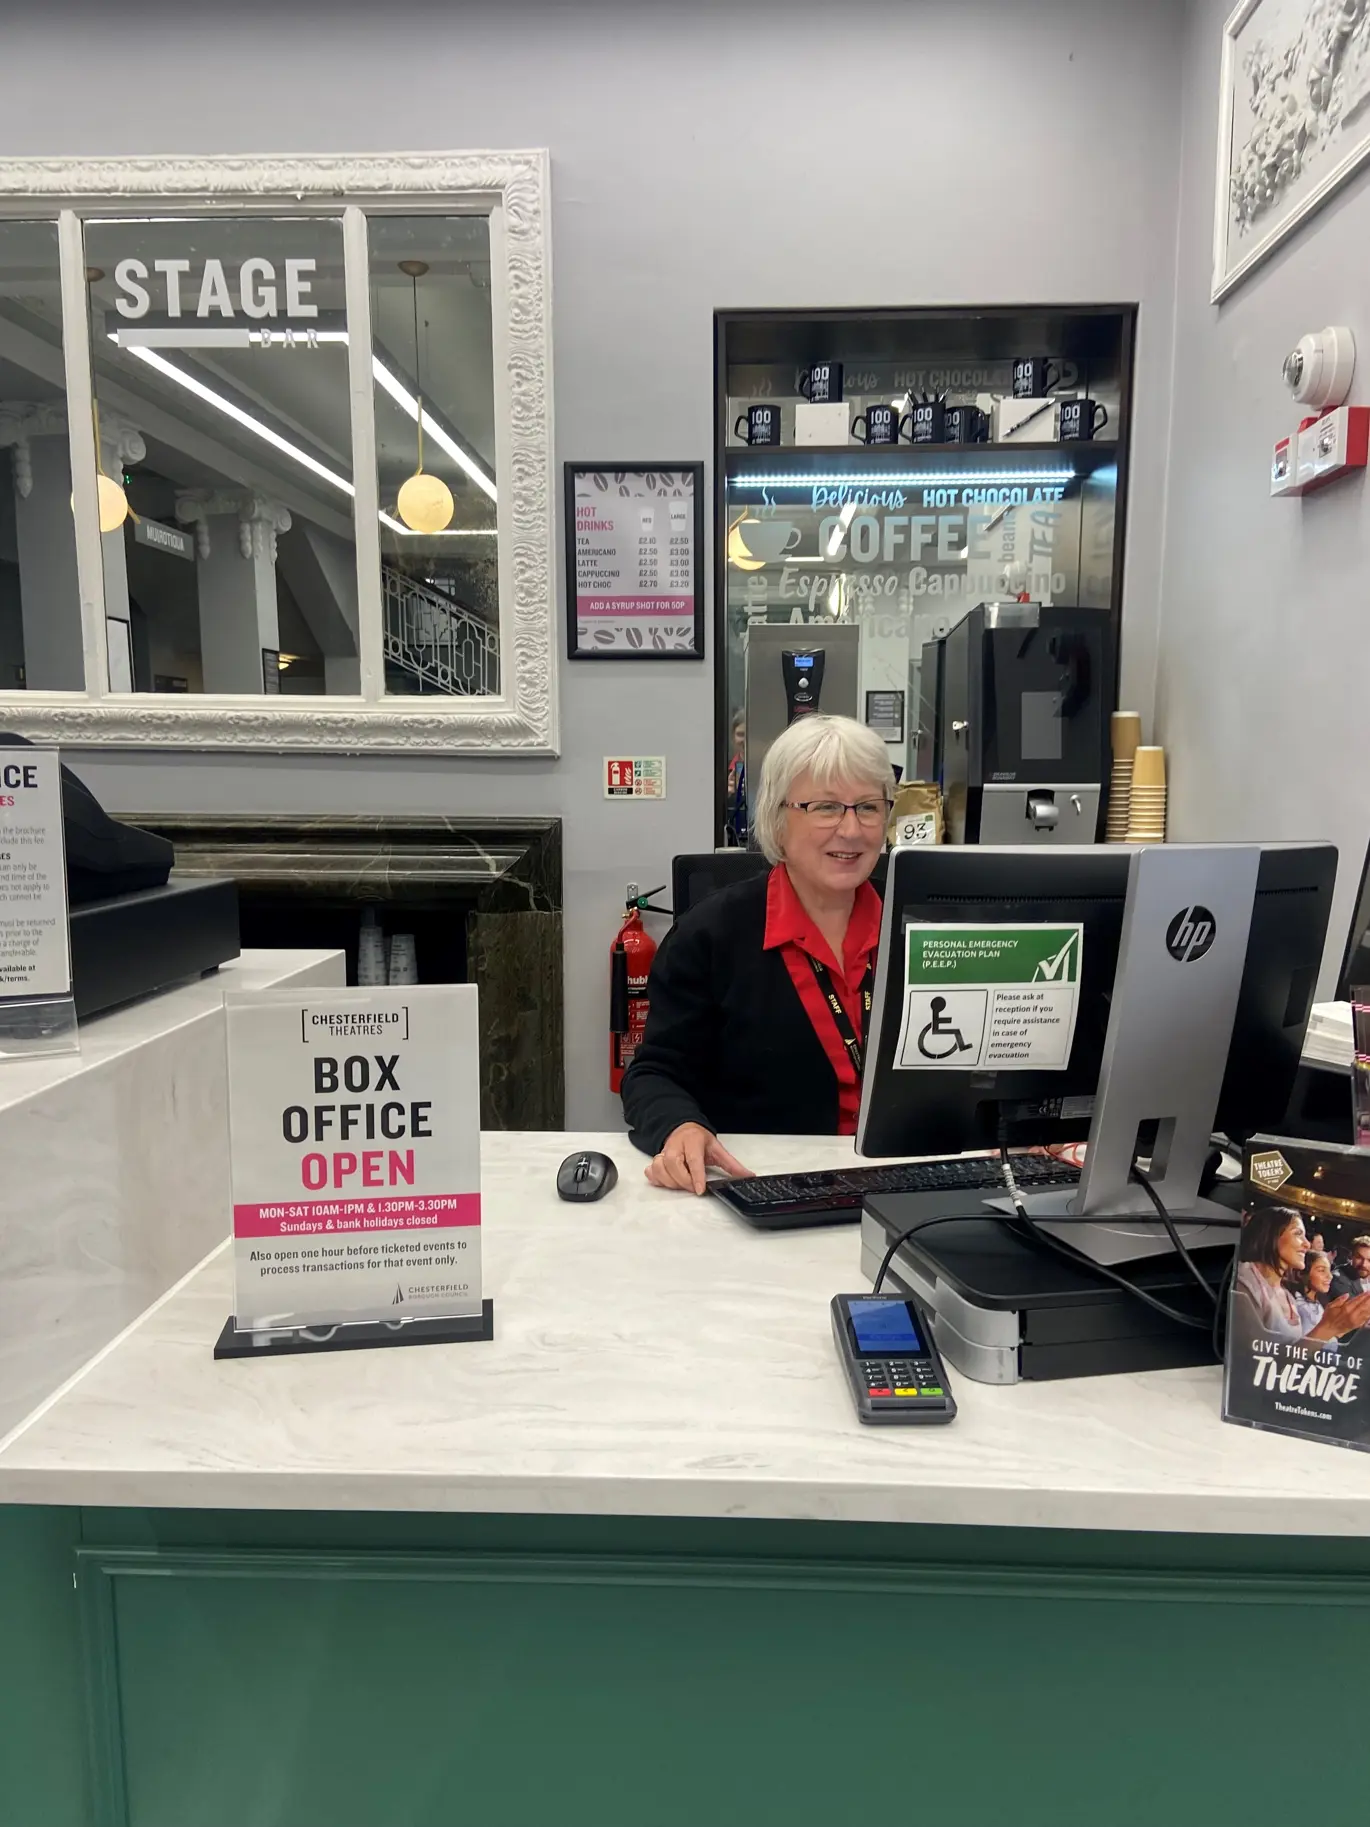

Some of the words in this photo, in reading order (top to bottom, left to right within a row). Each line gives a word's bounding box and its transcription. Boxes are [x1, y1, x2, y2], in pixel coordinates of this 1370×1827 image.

[114, 257, 319, 319] STAGE
[260, 328, 319, 349] BAR
[811, 366, 830, 382] 100
[1013, 363, 1033, 379] 100
[752, 410, 772, 425] 100
[870, 410, 891, 425] 100
[914, 406, 933, 423] 100
[1061, 405, 1081, 420] 100
[810, 484, 908, 513] Delicious
[922, 488, 958, 508] HOT
[961, 486, 1065, 507] CHOCOLATE
[576, 506, 597, 517] HOT
[576, 520, 614, 531] DRINKS
[577, 537, 590, 545] TEA
[669, 537, 689, 545] £2.50
[818, 514, 993, 564] COFFEE
[1028, 508, 1063, 564] TEA
[577, 548, 617, 556] AMERICANO
[638, 548, 658, 556] £2.50
[669, 548, 690, 556] £3.00
[577, 559, 598, 567] LATTE
[669, 559, 690, 567] £3.00
[577, 570, 620, 578] CAPPUCCINO
[578, 581, 592, 589] HOT
[592, 581, 612, 589] CHOC
[638, 580, 658, 588] £2.70
[589, 602, 605, 610] ADD
[605, 602, 611, 610] A
[611, 602, 635, 610] SYRUP
[636, 601, 655, 610] SHOT
[656, 601, 670, 609] FOR
[0, 765, 38, 788] CE
[15, 826, 46, 836] brochure
[26, 918, 56, 927] returned
[5, 930, 22, 940] prior
[23, 929, 32, 938] to
[32, 929, 43, 937] the
[1171, 905, 1212, 962] hp
[9, 939, 31, 949] charge
[922, 940, 967, 949] PERSONAL
[968, 940, 1019, 948] EMERGENCY
[922, 950, 977, 958] EVACUATION
[978, 950, 1000, 958] PLAN
[922, 960, 957, 969] (P.E.E.P.)
[864, 990, 872, 1011] STAFF
[996, 993, 1021, 1001] Please
[1022, 993, 1035, 1001] ask
[828, 993, 843, 1015] STAFF
[995, 1005, 1031, 1014] reception
[1032, 1004, 1039, 1013] if
[1039, 1006, 1054, 1014] you
[311, 1012, 399, 1025] CHESTERFIELD
[993, 1017, 1021, 1026] require
[329, 1024, 383, 1037] THEATRES
[992, 1029, 1000, 1037] in
[1019, 1028, 1028, 1036] of
[990, 1041, 1032, 1049] emergency
[988, 1051, 1030, 1059] evacuation
[313, 1054, 401, 1094] BOX
[282, 1101, 433, 1144] OFFICE
[301, 1149, 415, 1191] OPEN
[1253, 1158, 1284, 1171] THEATRE
[1257, 1167, 1285, 1179] TOKENS
[259, 1205, 310, 1219] MON-SAT
[311, 1203, 365, 1217] 10AM-1PM
[366, 1202, 376, 1214] &
[377, 1198, 458, 1213] 1.30PM-3.30PM
[279, 1220, 324, 1233] Sundays
[325, 1219, 335, 1230] &
[336, 1218, 361, 1230] bank
[362, 1215, 405, 1229] holidays
[405, 1213, 438, 1225] closed
[249, 1250, 272, 1262] Also
[274, 1250, 299, 1262] open
[300, 1249, 320, 1259] one
[321, 1246, 345, 1258] hour
[346, 1244, 379, 1257] before
[380, 1242, 421, 1255] ticketed
[422, 1240, 456, 1252] events
[457, 1239, 467, 1250] to
[260, 1264, 301, 1278] process
[302, 1259, 365, 1274] transactions
[366, 1259, 382, 1270] for
[383, 1257, 404, 1269] that
[405, 1256, 433, 1268] event
[434, 1254, 458, 1267] only.
[408, 1283, 469, 1294] CHESTERFIELD
[1251, 1339, 1280, 1356] GIVE
[1285, 1344, 1309, 1361] THE
[1313, 1350, 1342, 1367] GIFT
[1346, 1355, 1364, 1371] OF
[1252, 1354, 1361, 1404] THEATRE
[1274, 1401, 1333, 1421] TheatreTokens.com
